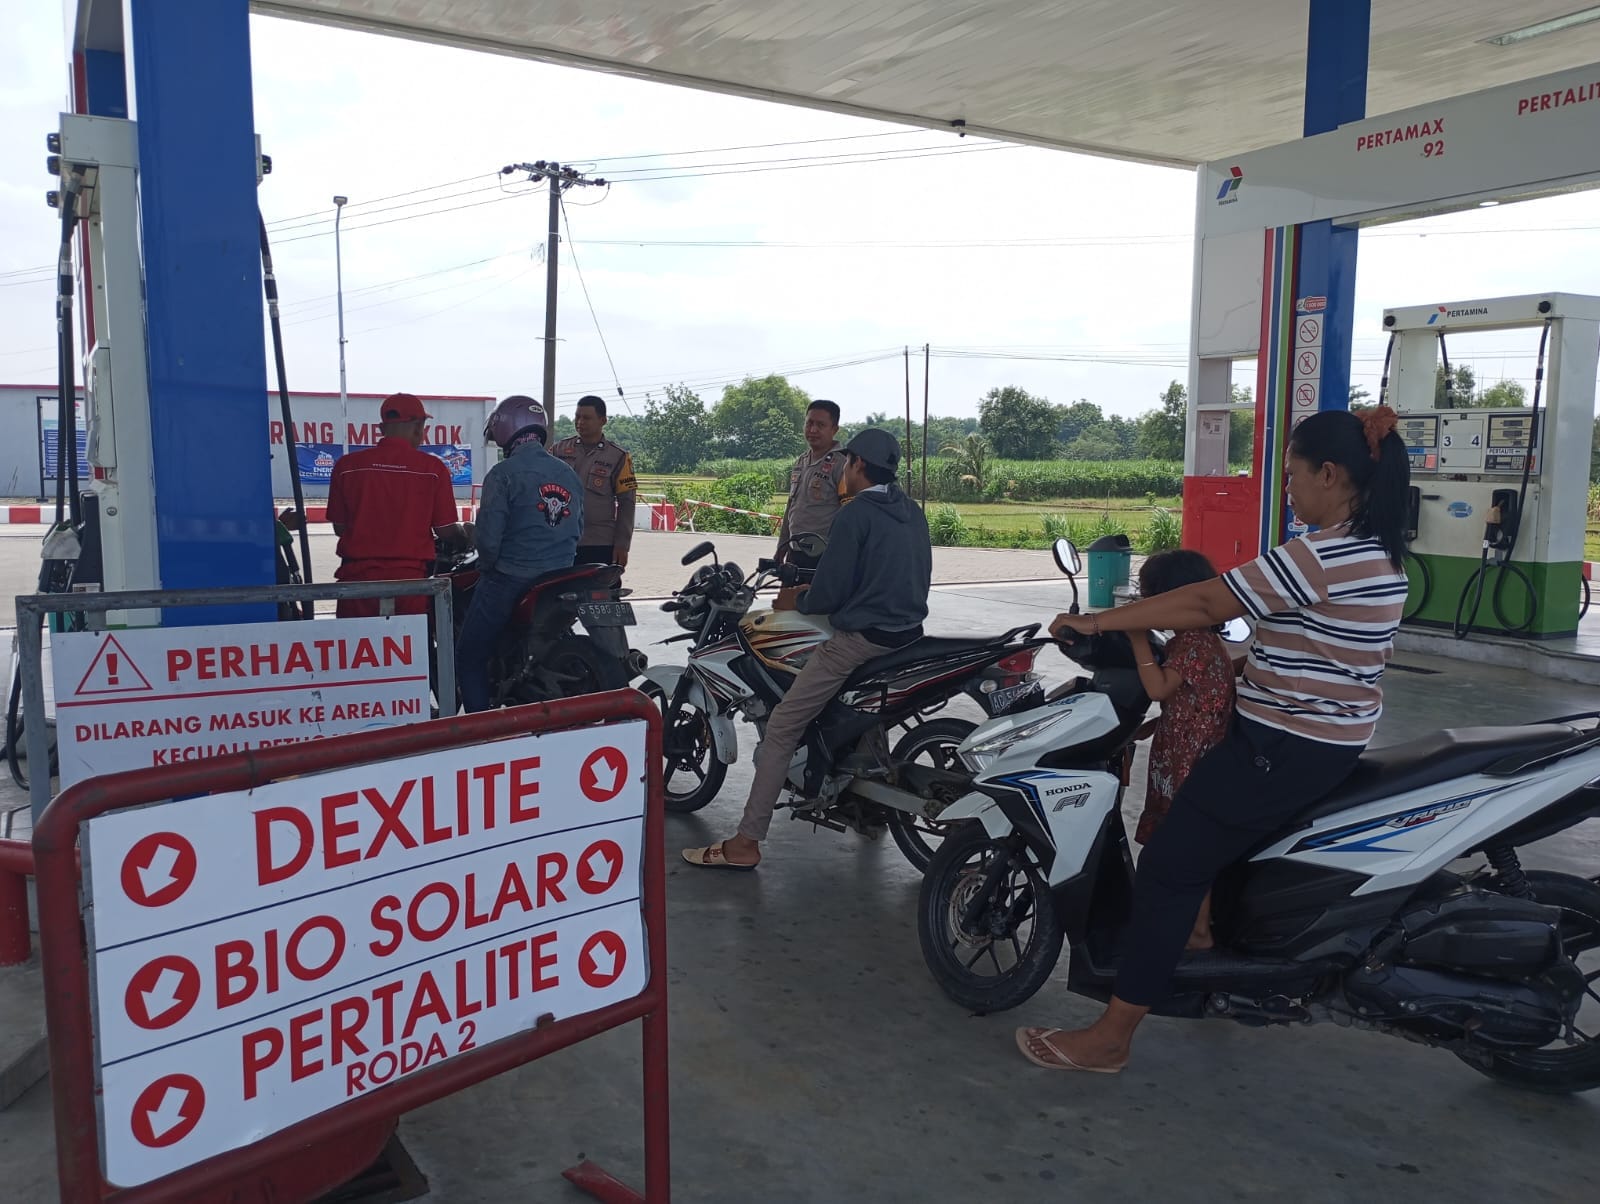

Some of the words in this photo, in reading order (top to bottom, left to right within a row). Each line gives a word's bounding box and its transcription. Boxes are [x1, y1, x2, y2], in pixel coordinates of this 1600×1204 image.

[1356, 118, 1444, 152] PERTAMAX
[1423, 140, 1444, 158] 92
[1446, 307, 1488, 318] PERTAMINA
[347, 422, 462, 446] MEKOK
[1443, 436, 1452, 447] 3
[1471, 435, 1480, 446] 4
[167, 635, 412, 682] PERHATIAN
[75, 715, 202, 742] DILARANG
[209, 708, 293, 732] MASUK
[300, 705, 326, 723] KE
[331, 701, 386, 721] AREA
[392, 698, 421, 716] INI
[1044, 782, 1093, 797] HONDA
[253, 756, 541, 887] DEXLITE
[214, 914, 346, 1010] BIO
[369, 851, 569, 958] SOLAR
[242, 930, 560, 1101] PERTALITE
[346, 1032, 448, 1097] RODA
[457, 1019, 477, 1053] 2
